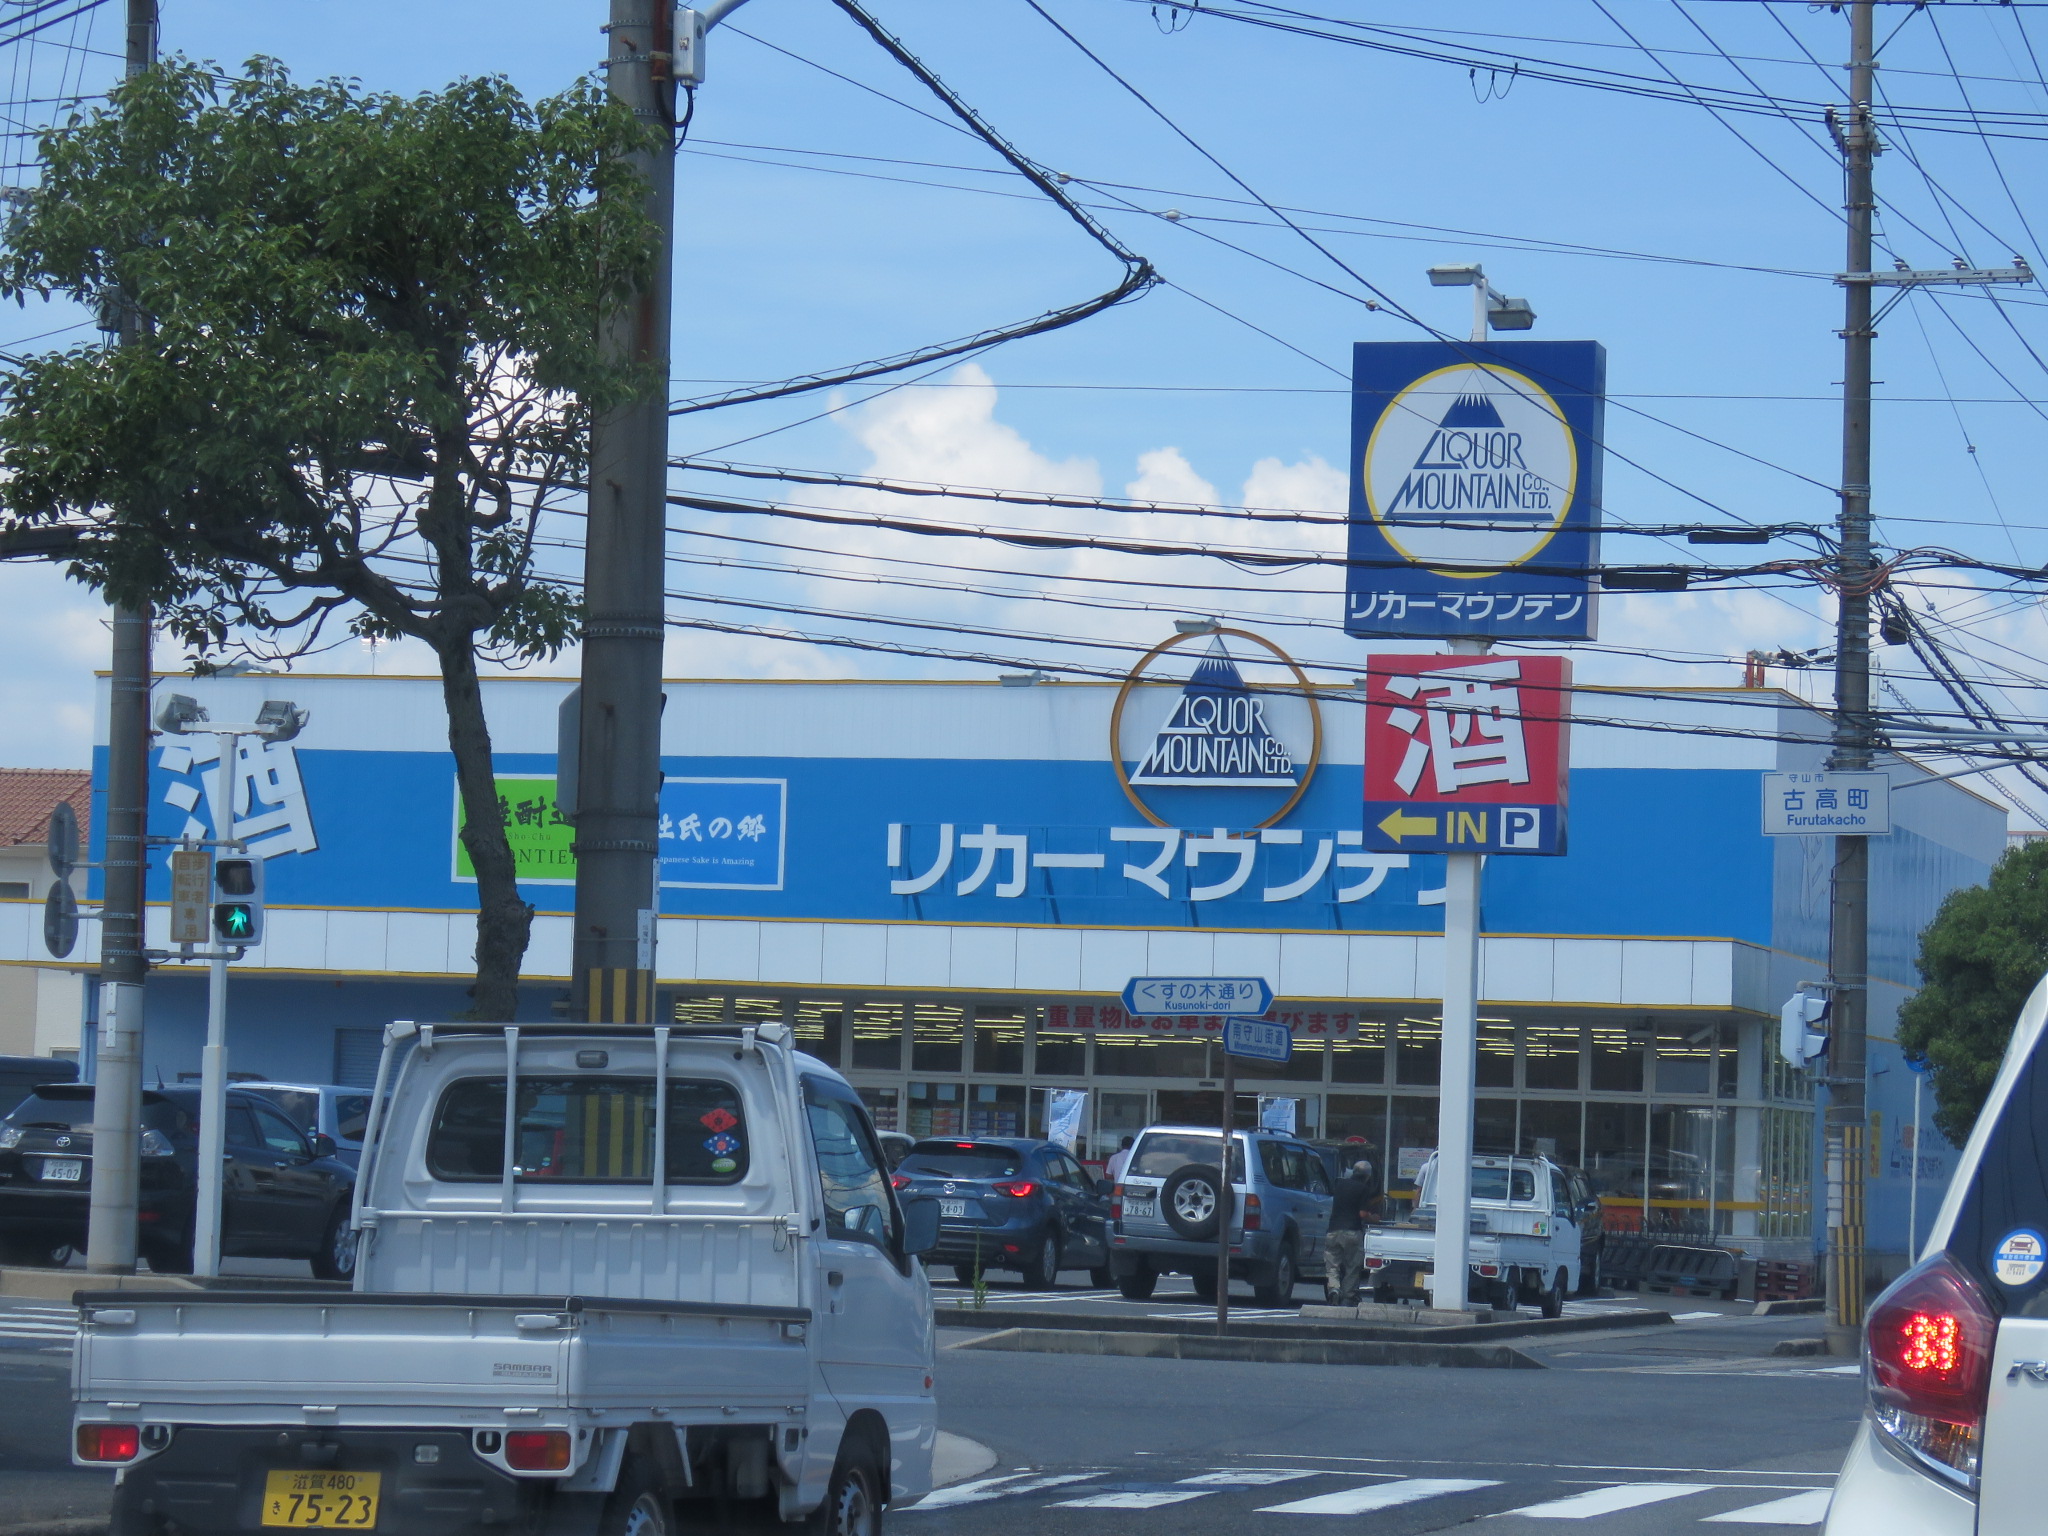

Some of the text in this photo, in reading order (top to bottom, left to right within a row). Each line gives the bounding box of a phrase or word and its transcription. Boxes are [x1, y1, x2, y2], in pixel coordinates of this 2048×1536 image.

[1413, 430, 1527, 469] LIQUOR
[1383, 472, 1520, 513] MOUNTAIN
[1522, 492, 1551, 509] LTD.
[1351, 591, 1582, 621] リカーマウンテン
[1159, 694, 1270, 735] LIQUOR
[1385, 659, 1530, 797] 酒
[1129, 735, 1264, 777] MOUNTAIN
[1264, 756, 1294, 774] LTD.
[1788, 773, 1825, 783] 守山市
[1783, 788, 1869, 811] 古高町
[1446, 811, 1535, 845] IN P
[1787, 814, 1866, 826] Furutakacho
[721, 858, 755, 867] Amazing
[1141, 982, 1253, 1000] くすの木通り
[1165, 1001, 1231, 1011] Kusunoki-dori
[1129, 1205, 1152, 1216] 78-67
[493, 1363, 552, 1372] SAMBAR
[288, 1494, 372, 1524] 75-23
